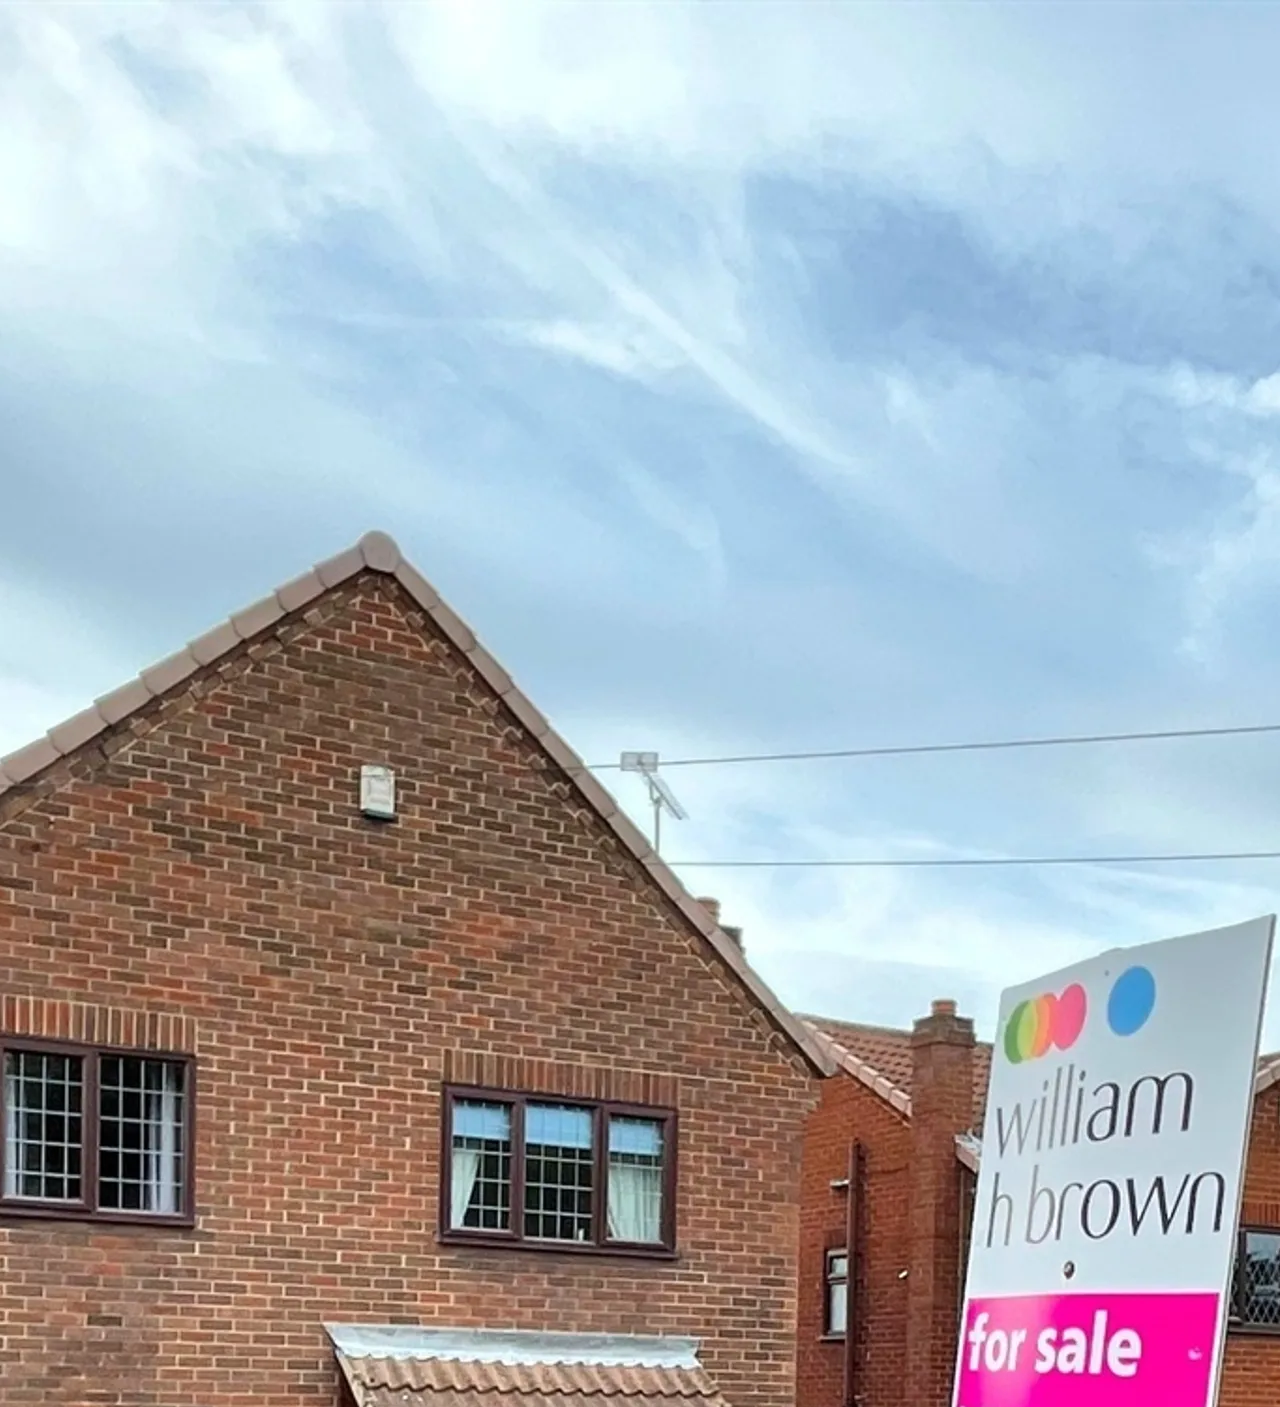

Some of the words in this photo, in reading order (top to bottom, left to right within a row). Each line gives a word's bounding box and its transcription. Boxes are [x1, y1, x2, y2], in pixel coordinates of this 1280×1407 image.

[996, 1064, 1194, 1159] william
[987, 1172, 1014, 1248] h
[1025, 1164, 1226, 1245] brown
[968, 1311, 1027, 1373] for
[1034, 1309, 1142, 1377] sale
